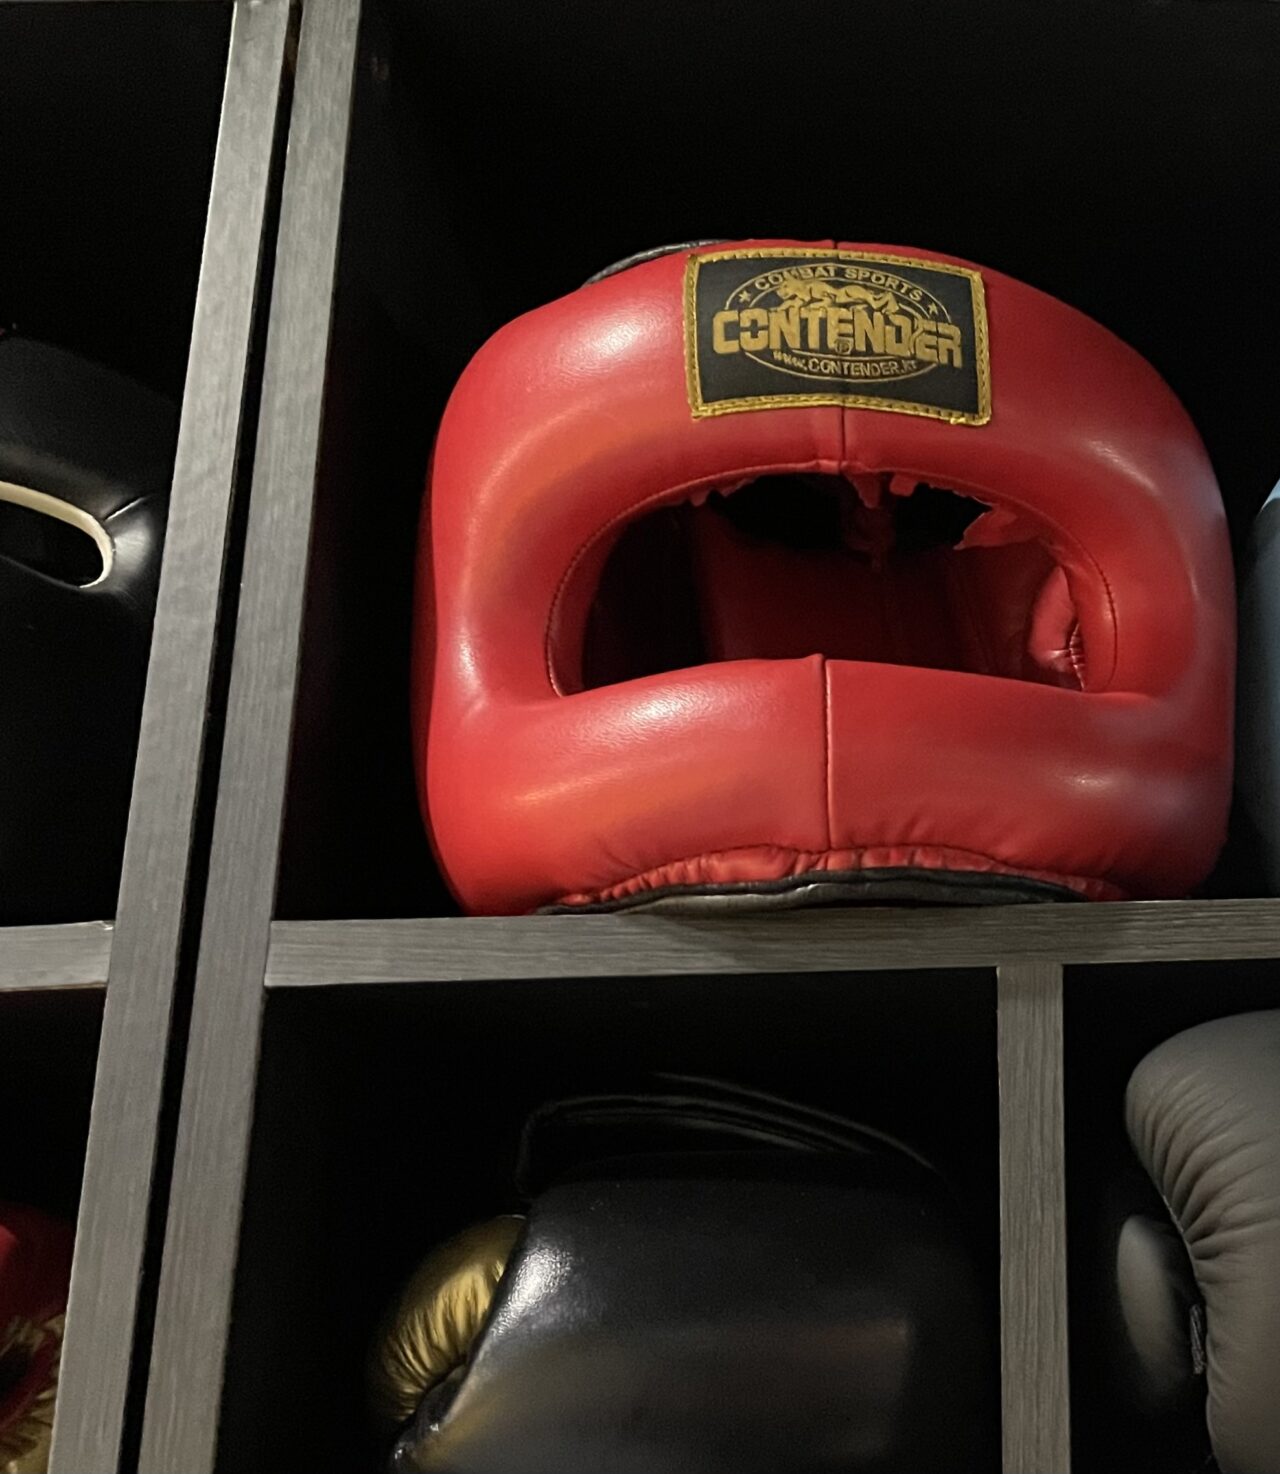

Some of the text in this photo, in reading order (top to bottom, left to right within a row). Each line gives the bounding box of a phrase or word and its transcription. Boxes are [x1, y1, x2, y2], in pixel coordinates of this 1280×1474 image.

[754, 266, 924, 301] COMBAT SPORTS
[712, 305, 963, 369] CONTENDER
